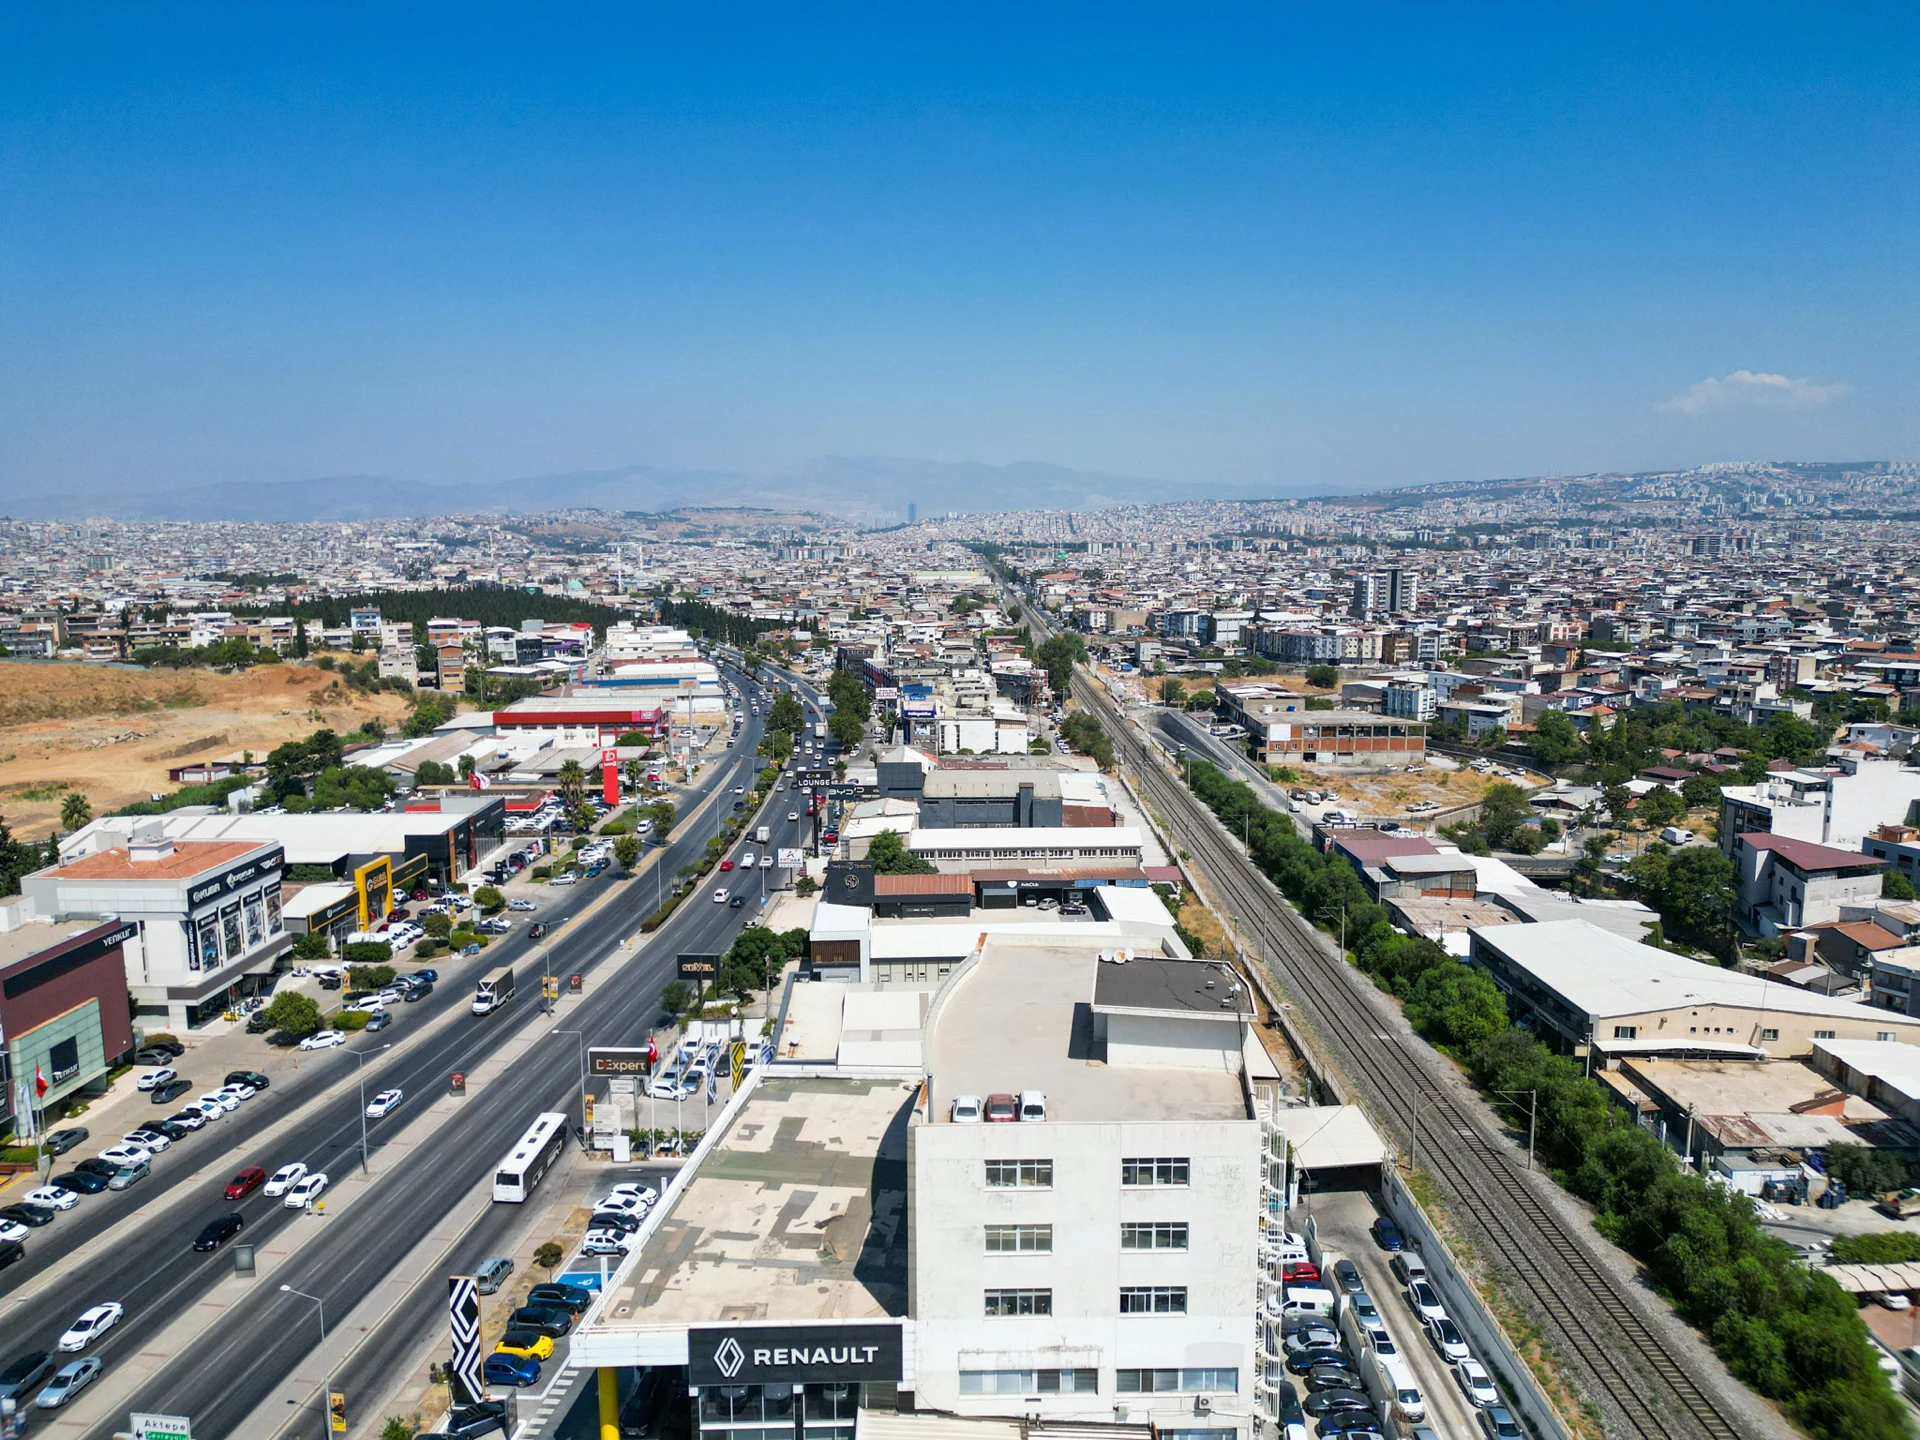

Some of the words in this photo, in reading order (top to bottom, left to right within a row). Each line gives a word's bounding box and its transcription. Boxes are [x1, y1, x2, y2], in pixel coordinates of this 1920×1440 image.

[200, 882, 220, 899] KUBA
[754, 1346, 879, 1366] RENAULT
[144, 1419, 186, 1432] Aktepe
